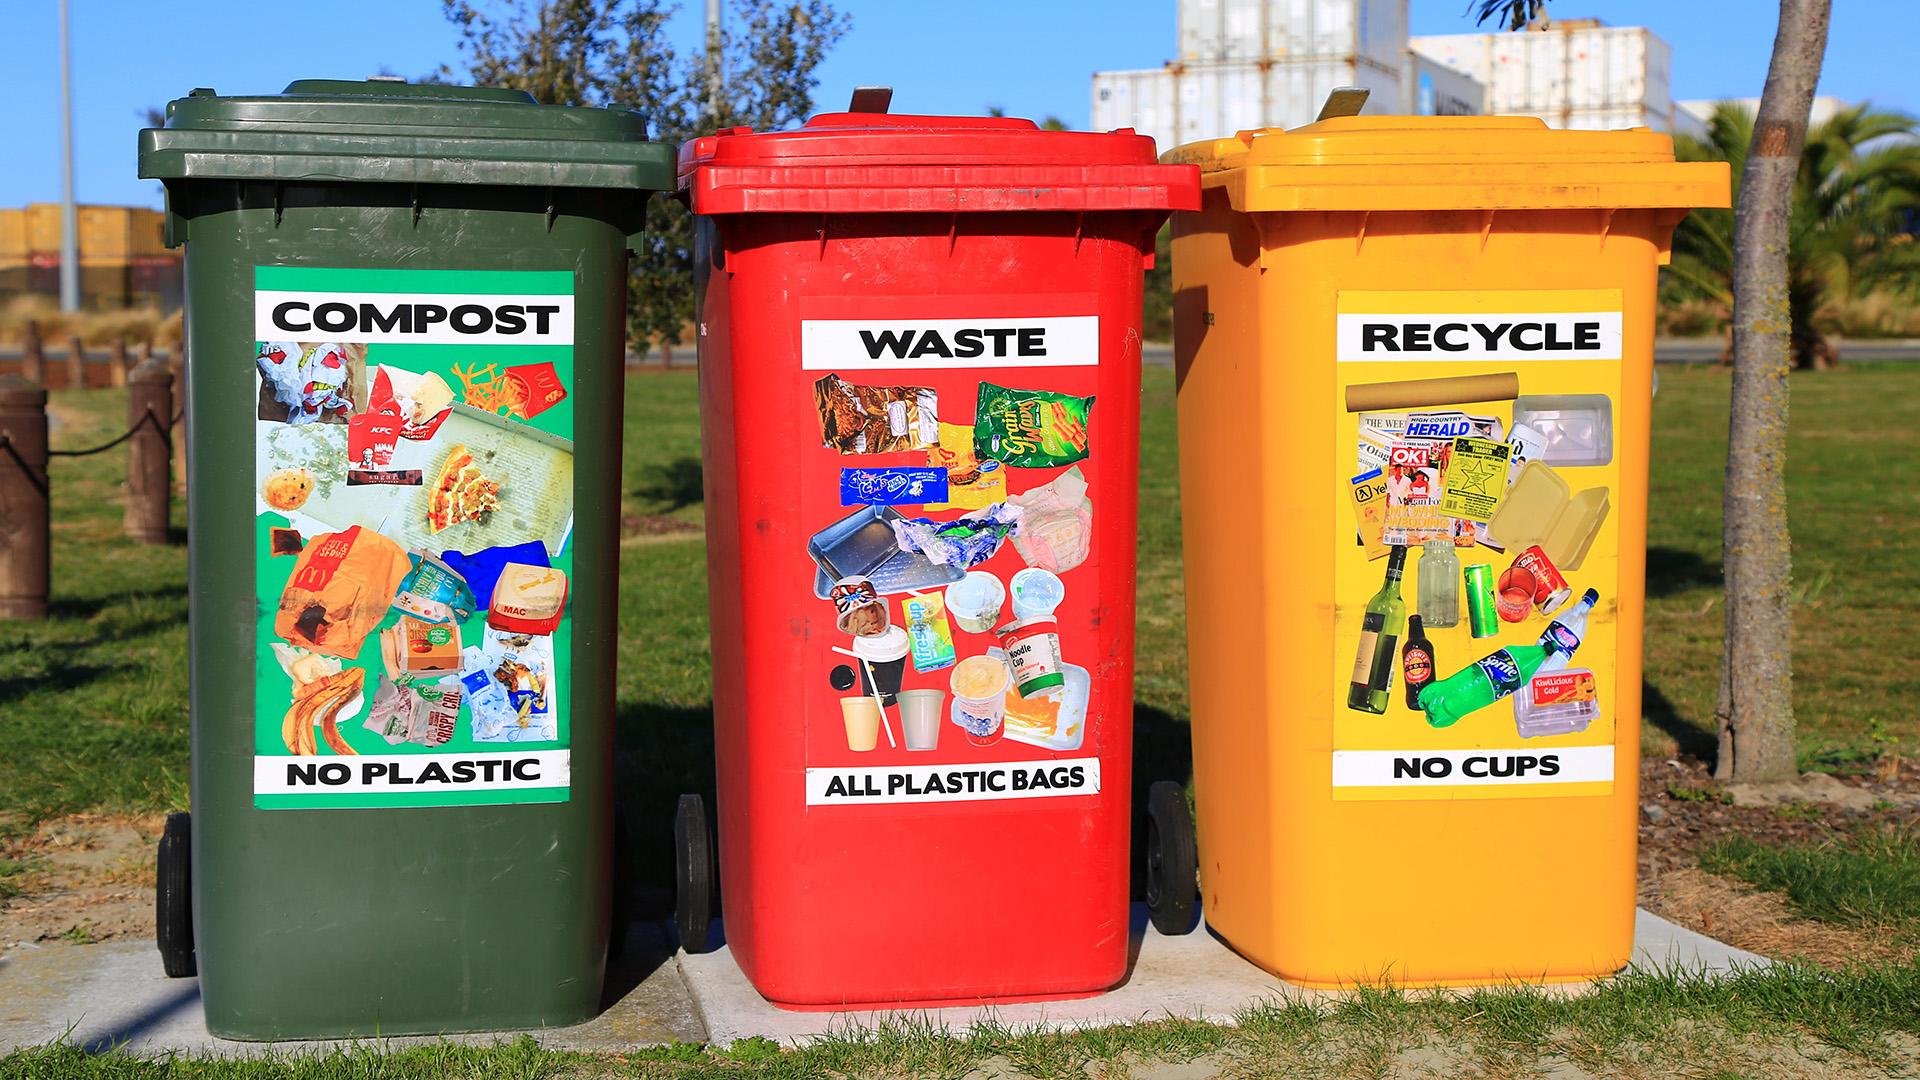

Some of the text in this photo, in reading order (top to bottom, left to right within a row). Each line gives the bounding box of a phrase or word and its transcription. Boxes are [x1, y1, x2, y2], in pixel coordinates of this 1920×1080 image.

[273, 302, 560, 334] COMPOST
[859, 328, 1046, 359] WASTE
[1363, 322, 1601, 351] RECYCLE
[370, 427, 393, 435] KFC
[1002, 409, 1034, 455] Grain
[1406, 422, 1470, 436] HERALD
[1366, 445, 1391, 462] Otag
[1393, 449, 1427, 464] OK!
[1373, 483, 1388, 495] Yel
[503, 605, 527, 616] MAC
[1009, 644, 1032, 659] Noodle
[1012, 657, 1024, 667] Cup
[1480, 655, 1518, 677] Sprite
[1544, 686, 1560, 695] Gold
[436, 712, 456, 744] CRISPY
[287, 759, 541, 785] NO PLASTIC
[1394, 755, 1560, 778] NO CUPS
[825, 767, 1085, 796] ALL PLASTIC BAGS
